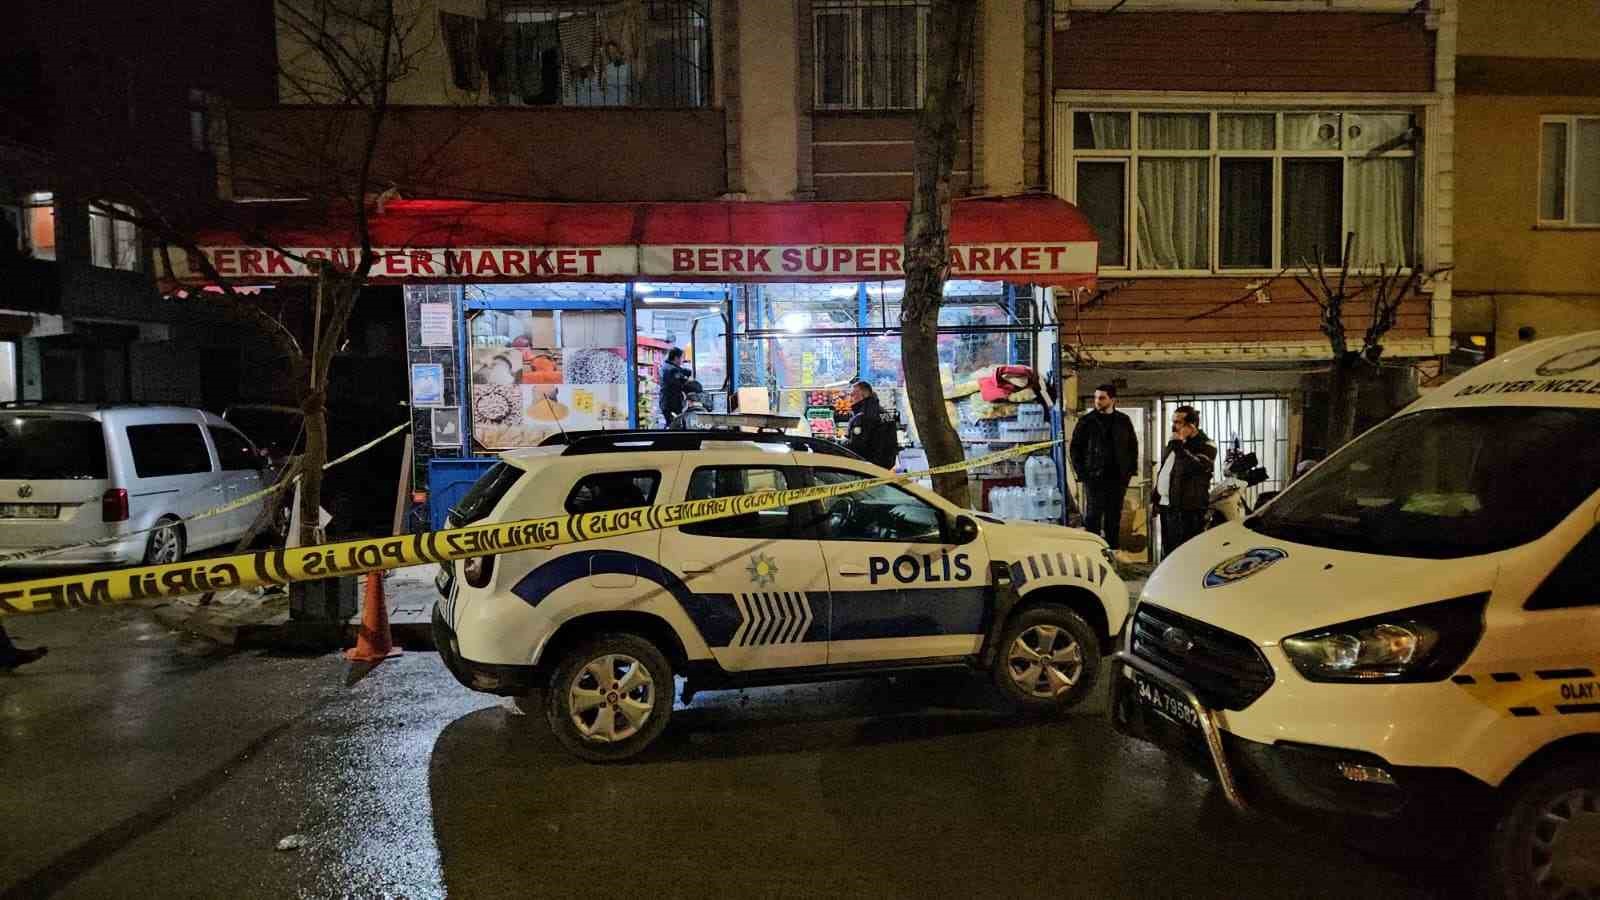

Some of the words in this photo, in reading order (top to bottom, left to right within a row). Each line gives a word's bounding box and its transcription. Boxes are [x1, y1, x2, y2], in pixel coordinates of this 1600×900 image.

[444, 250, 602, 274] MARKET
[673, 248, 772, 272] BERK
[781, 246, 899, 272] SÜPER
[950, 247, 1066, 272] ARKET
[869, 548, 972, 584] POLİS
[1561, 682, 1593, 699] OLAY
